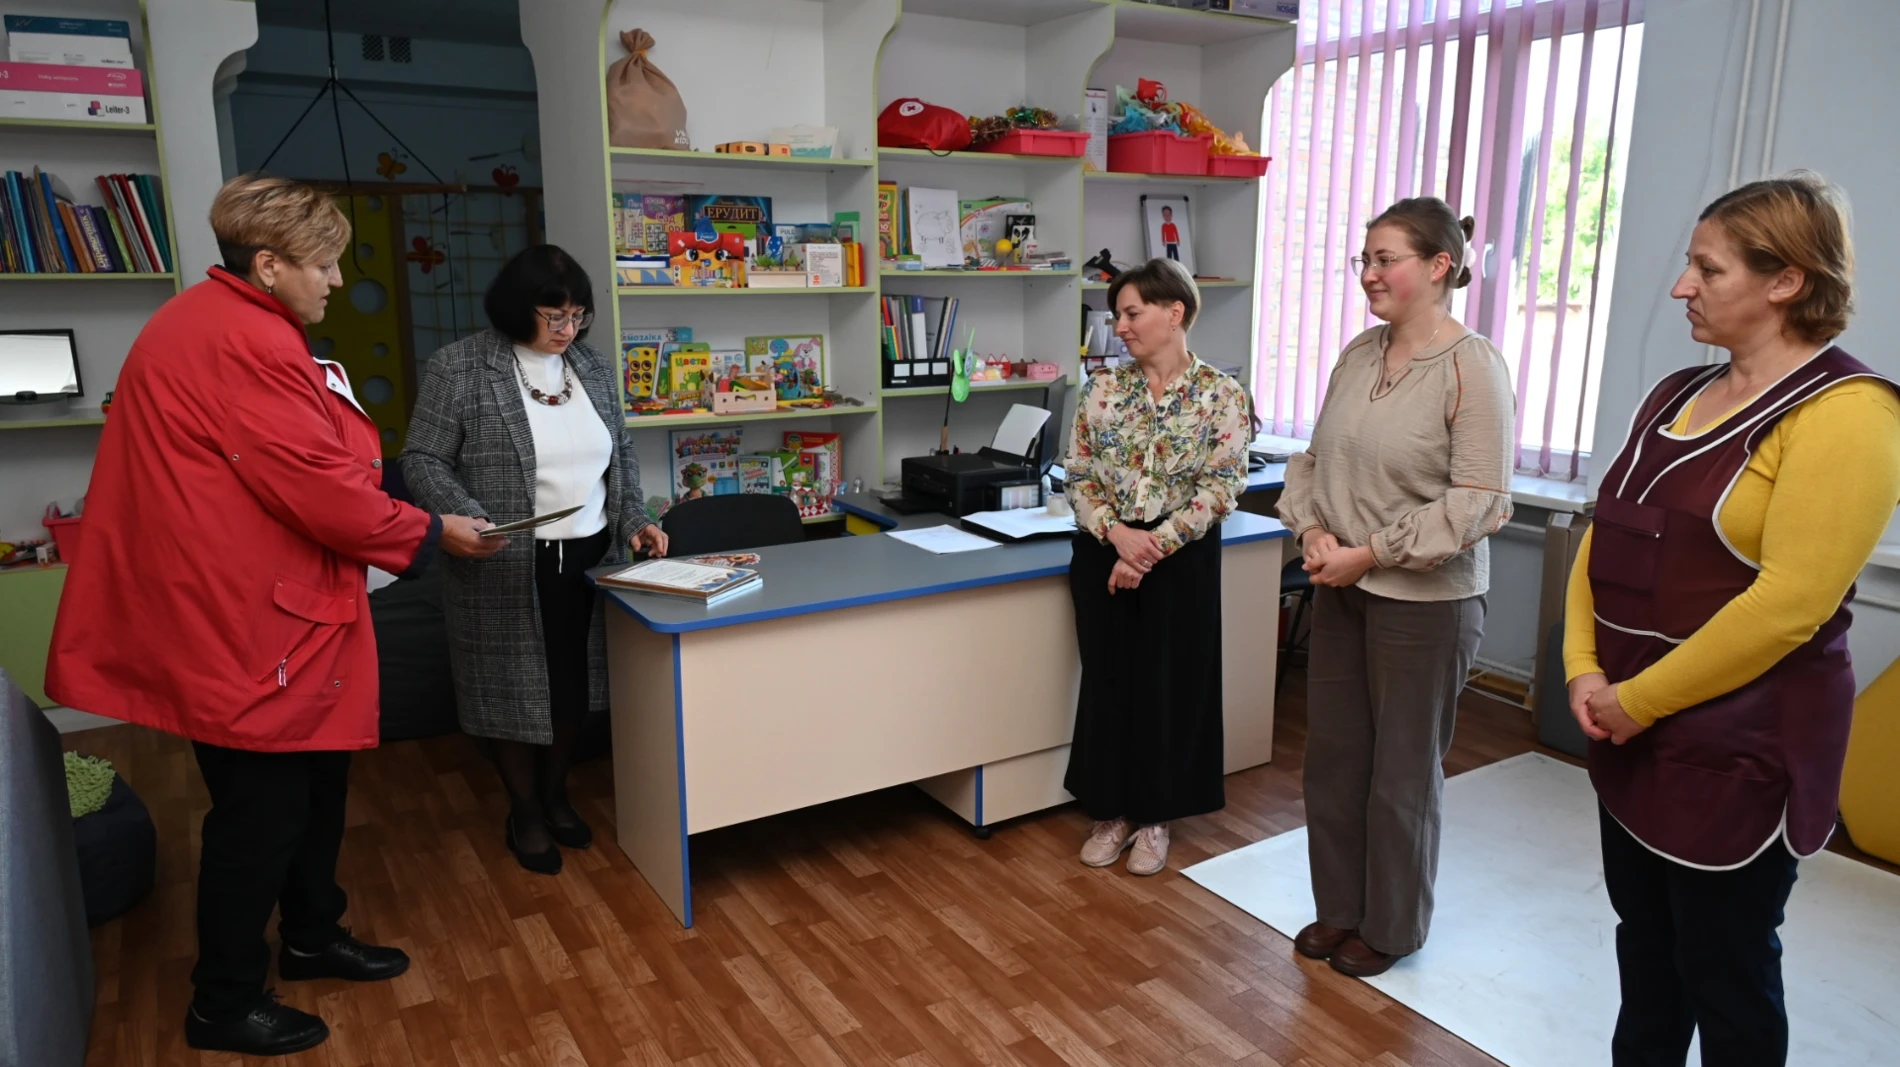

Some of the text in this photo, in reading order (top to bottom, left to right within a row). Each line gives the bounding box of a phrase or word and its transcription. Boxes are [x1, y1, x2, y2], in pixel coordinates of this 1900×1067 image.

[1276, 5, 1298, 14] EPSON
[105, 105, 130, 114] Leiter-3
[707, 207, 758, 220] ЕРУДИТ
[675, 357, 707, 367] Цвета
